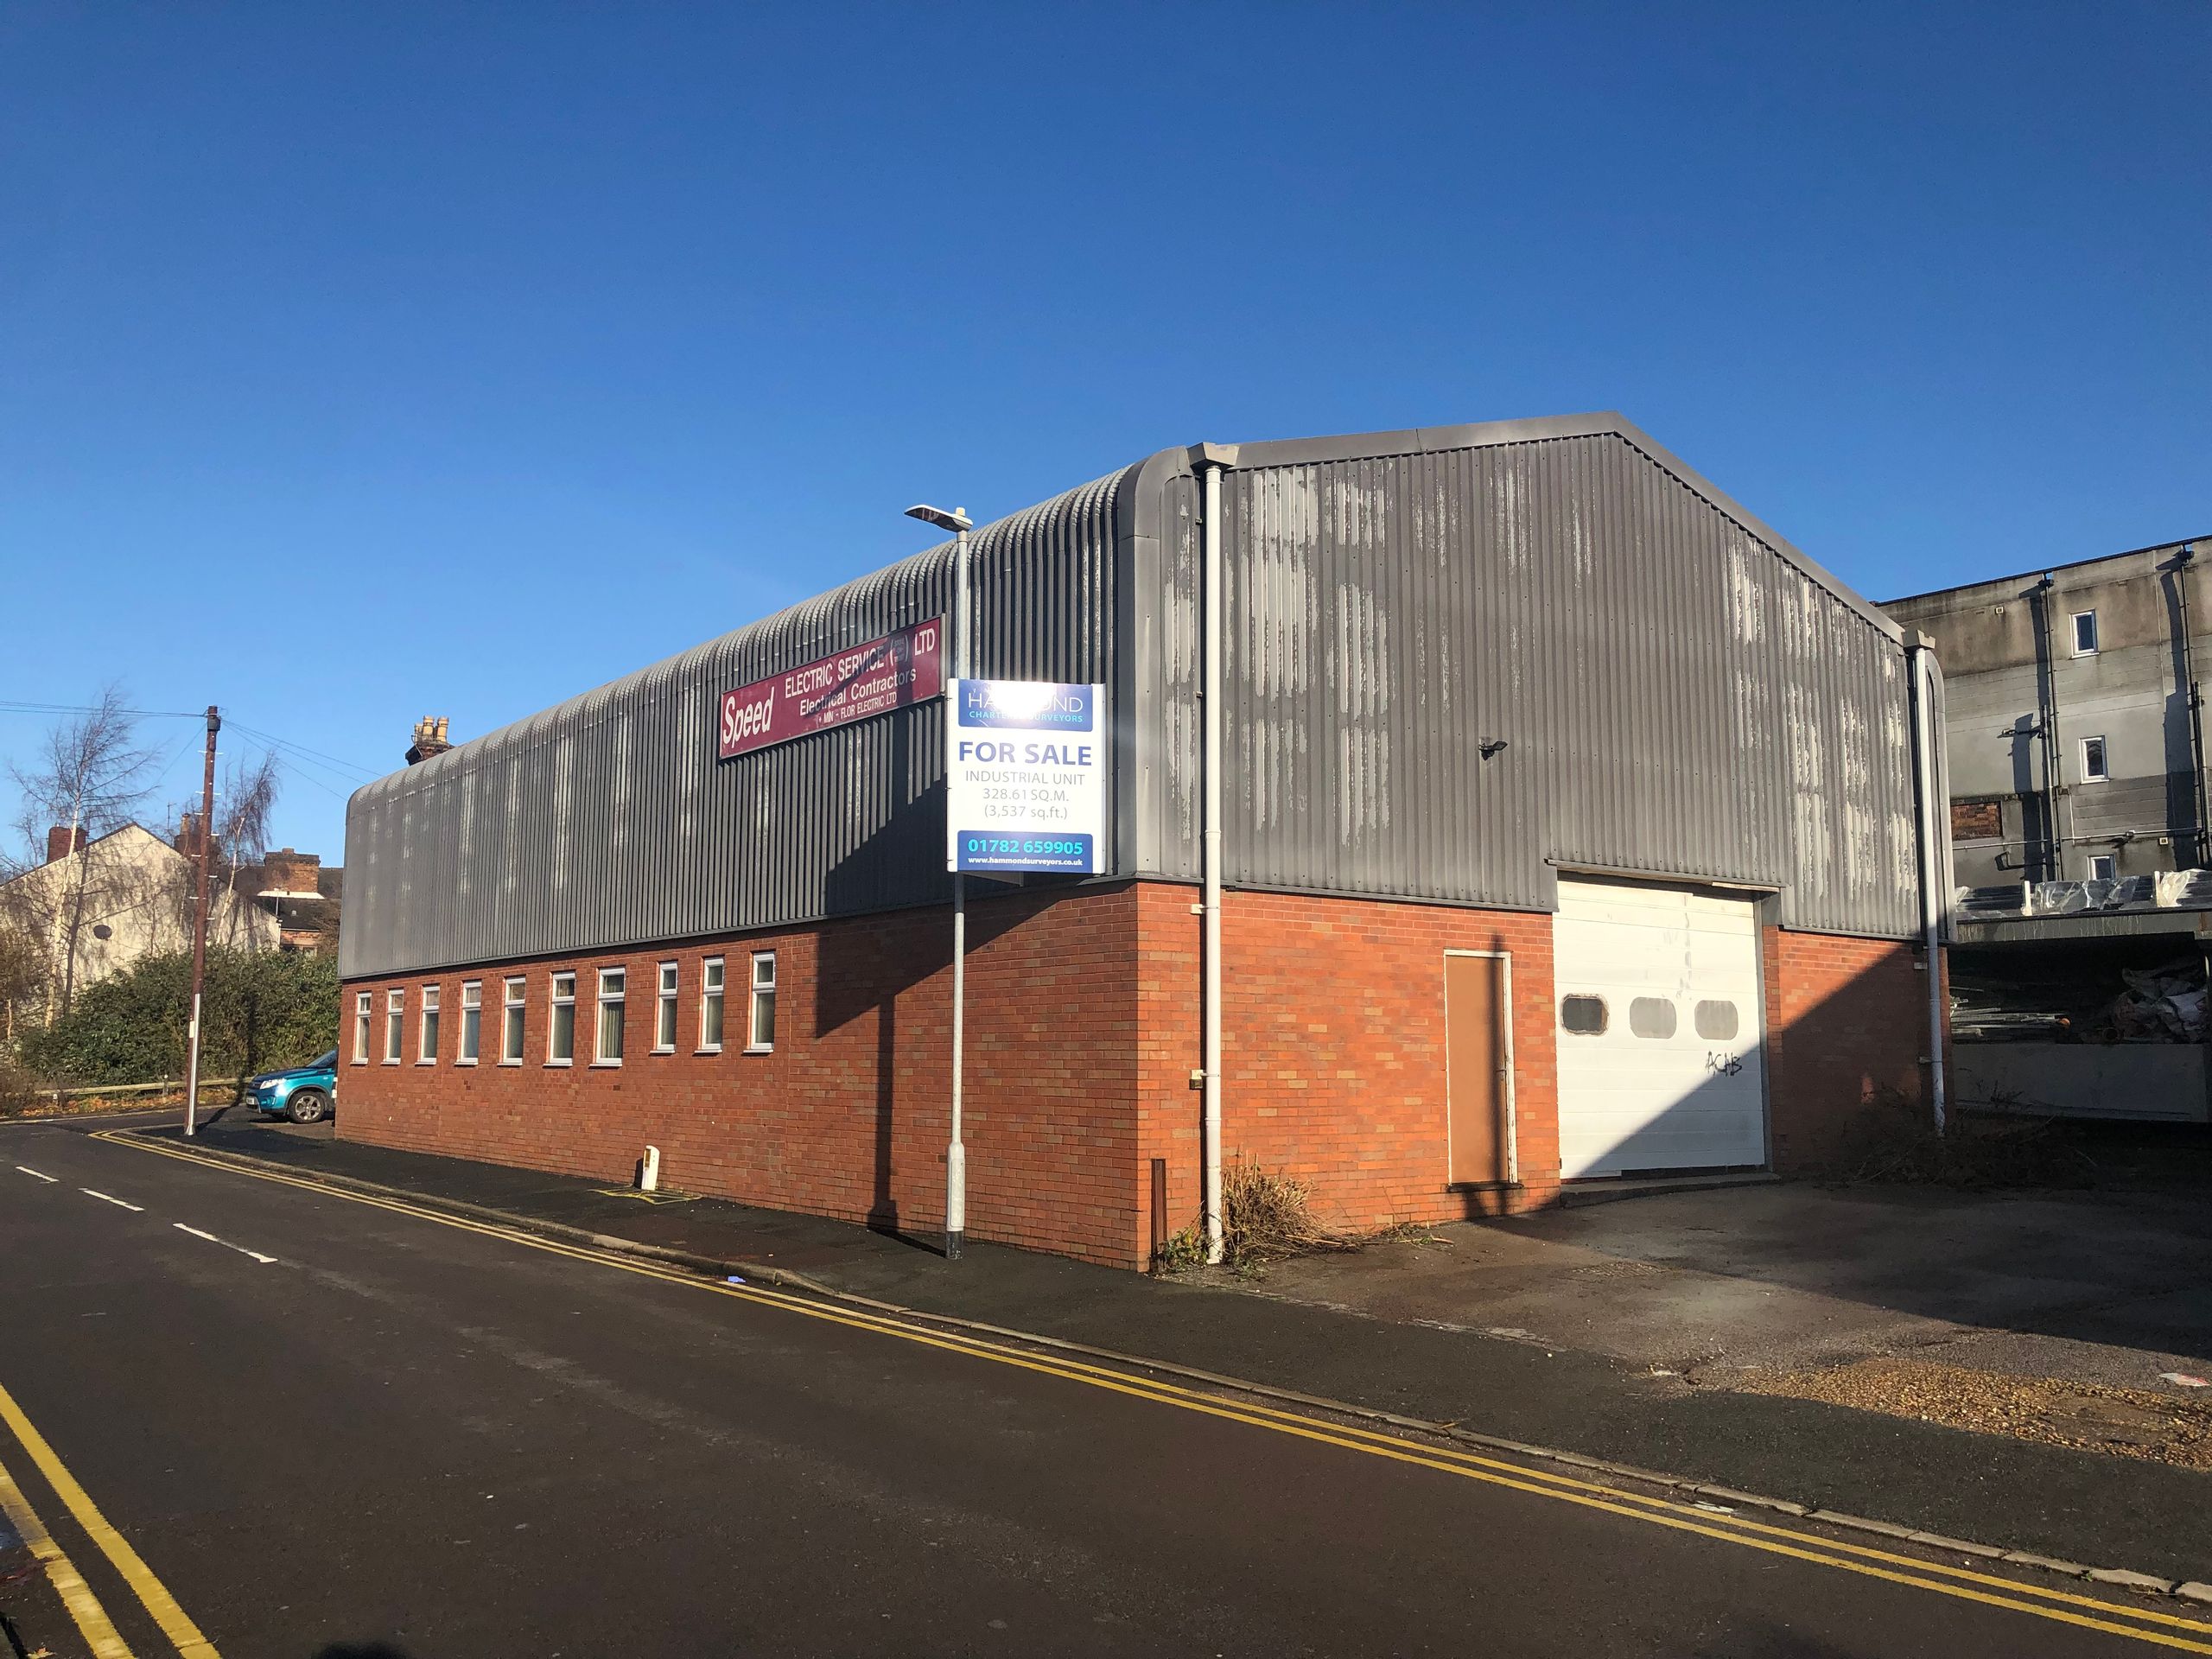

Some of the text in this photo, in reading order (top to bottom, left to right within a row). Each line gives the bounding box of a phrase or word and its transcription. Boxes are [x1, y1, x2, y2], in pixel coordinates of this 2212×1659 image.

[785, 664, 833, 699] ELECTRIC
[837, 645, 885, 683] SERVICE
[914, 627, 936, 656] LTD
[799, 668, 916, 716] Electrical Contractors
[856, 696, 885, 715] ELECTRIC
[886, 691, 898, 706] LTD
[721, 686, 774, 749] Speed
[958, 741, 1092, 766] FOR SALE
[965, 770, 1086, 785] INDUSTRIAL UNIT
[982, 787, 1070, 803] 328.61 SQ.M.
[984, 804, 1068, 821] (3,537 sq.ft.)
[968, 839, 1084, 855] 01782 659905
[968, 856, 1084, 867] www.hammondsurveyors.co.uk
